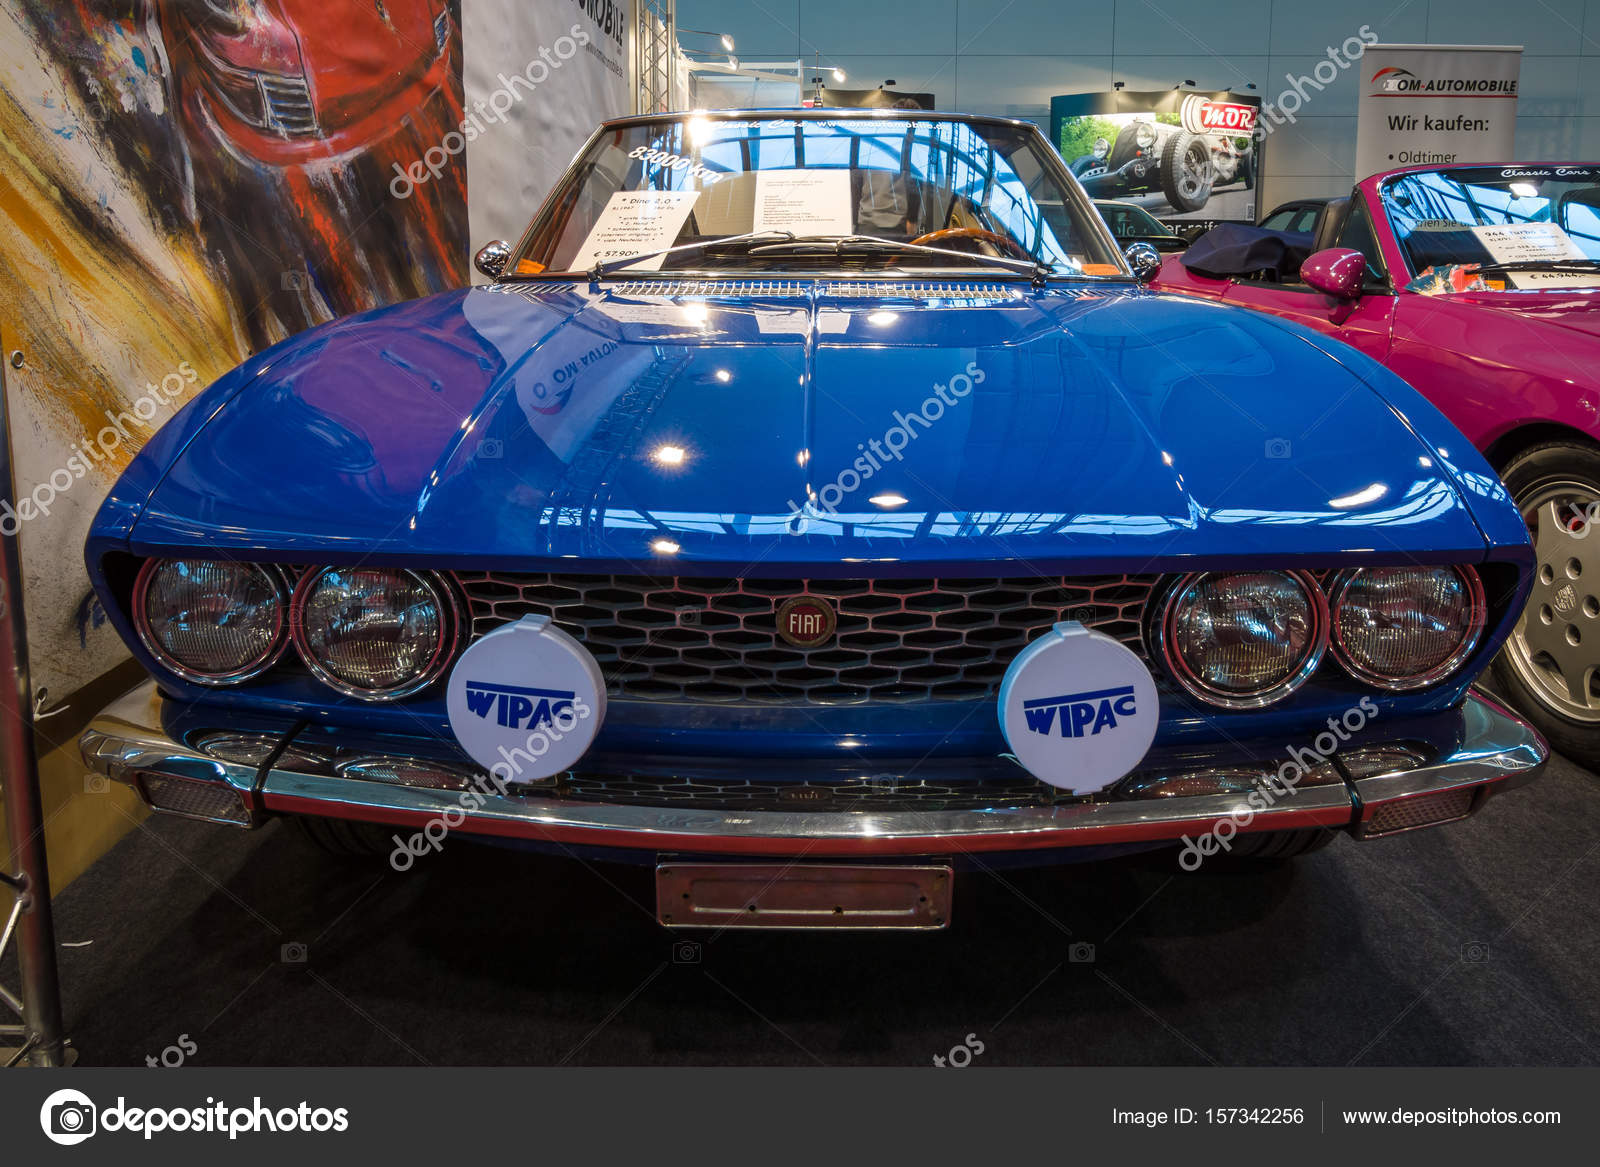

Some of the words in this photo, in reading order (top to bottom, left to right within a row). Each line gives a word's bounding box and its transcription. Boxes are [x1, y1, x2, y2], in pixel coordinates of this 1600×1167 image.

[1388, 115, 1418, 131] Wir
[1424, 115, 1489, 131] kaufen:
[628, 146, 690, 170] 83000
[689, 163, 724, 183] km
[1398, 151, 1457, 163] Oldtimer
[1501, 168, 1551, 177] Classic
[1556, 168, 1591, 176] Cars
[790, 613, 822, 634] FIAT
[466, 690, 577, 730] WIPAC
[1024, 695, 1136, 738] WIPAC
